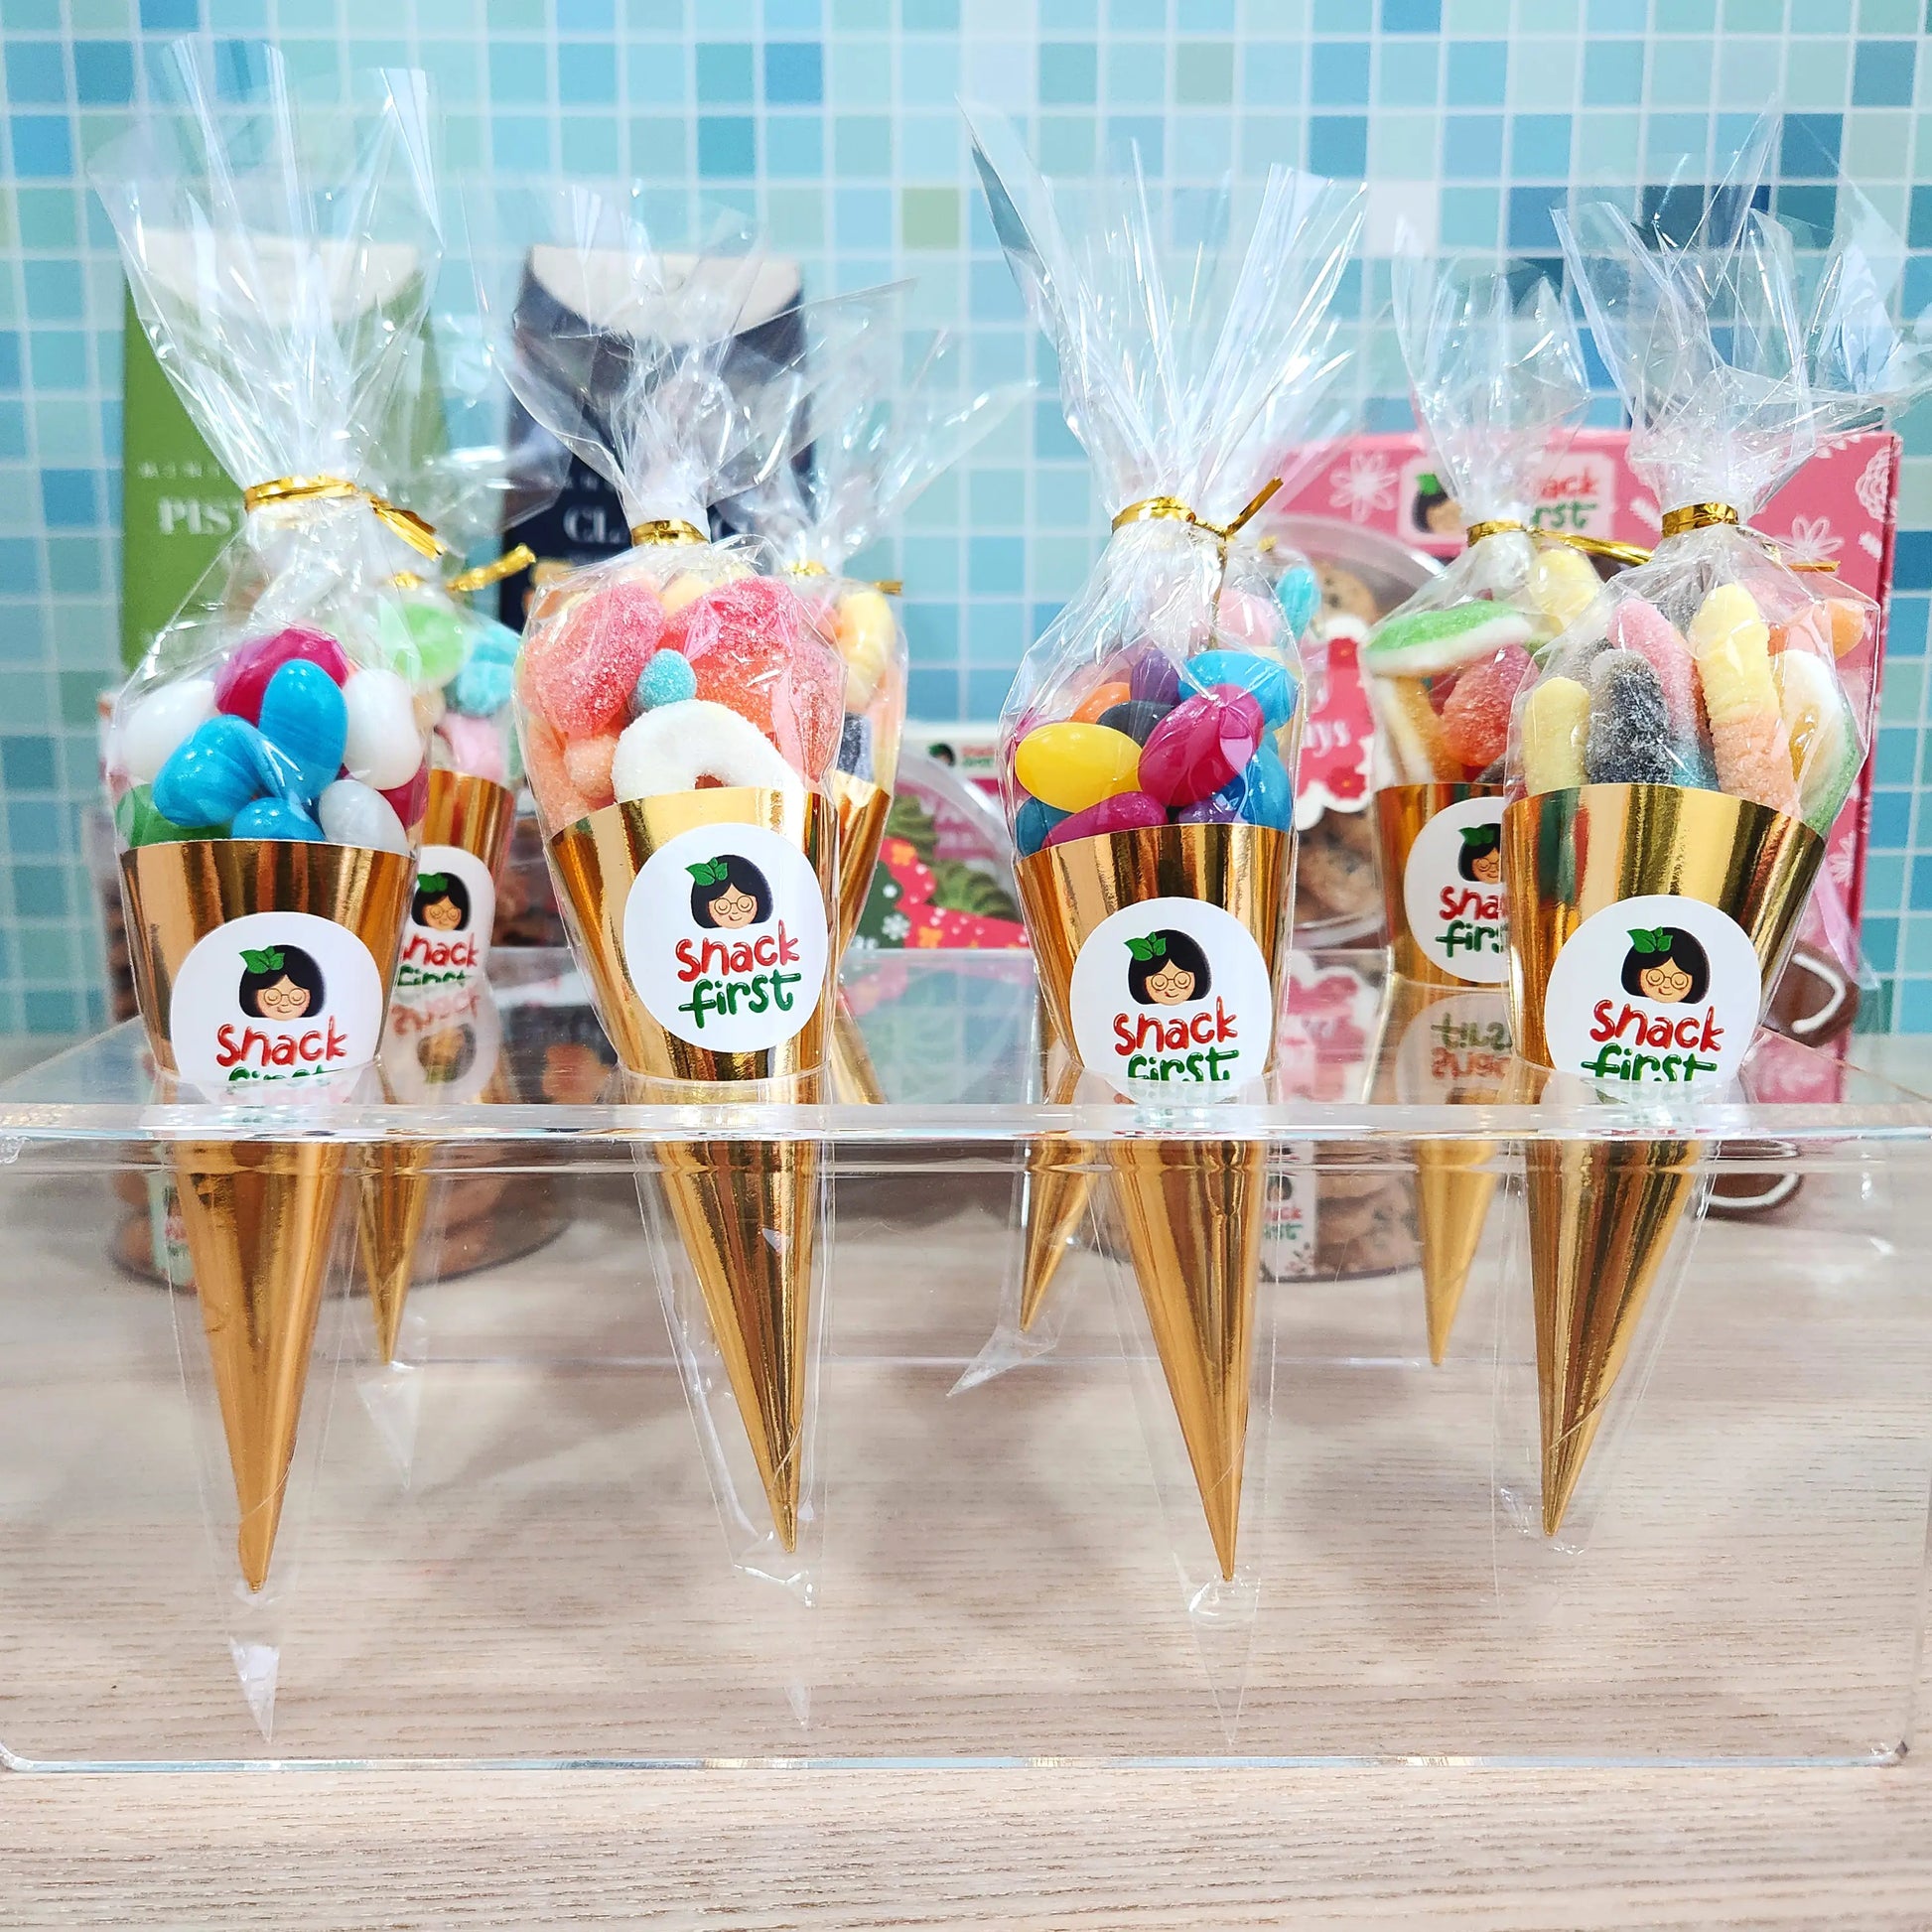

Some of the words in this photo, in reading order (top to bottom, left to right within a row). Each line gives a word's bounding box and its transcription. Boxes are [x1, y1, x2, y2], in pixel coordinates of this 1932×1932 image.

[158, 497, 246, 535] PIS
[402, 933, 480, 968] nack
[676, 919, 800, 982] snack
[678, 969, 802, 1029] first
[216, 1016, 348, 1067] snack
[1113, 996, 1238, 1055] snack
[1589, 999, 1725, 1052] snack
[1581, 1042, 1718, 1082] first
